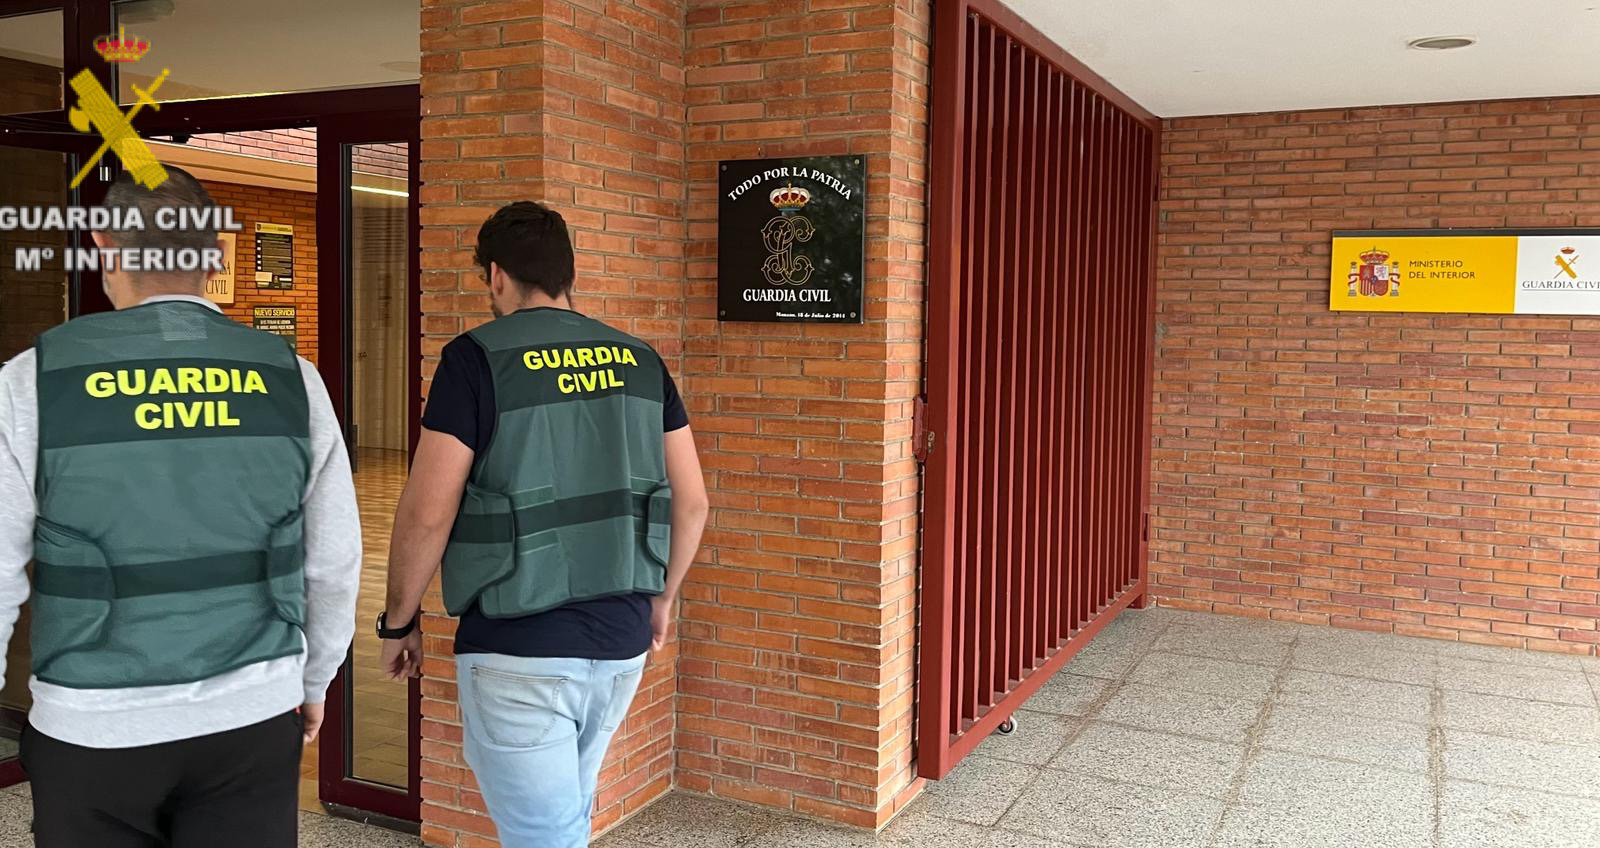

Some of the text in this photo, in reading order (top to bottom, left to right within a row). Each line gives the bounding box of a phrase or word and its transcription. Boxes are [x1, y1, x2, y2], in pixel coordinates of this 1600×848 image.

[728, 166, 852, 200] TODO POR LA PATRIA
[1409, 260, 1463, 268] MINISTERIO
[1408, 271, 1475, 280] DEL INTERIOR
[1522, 280, 1600, 289] GUARDIA CIVI
[205, 279, 228, 295] CIVIL
[743, 288, 831, 302] GUARDIA CIVIL
[523, 346, 638, 370] GUARDIA
[85, 367, 268, 398] GUARDIA
[558, 369, 624, 394] CIVIL
[135, 401, 240, 430] CIVIL
